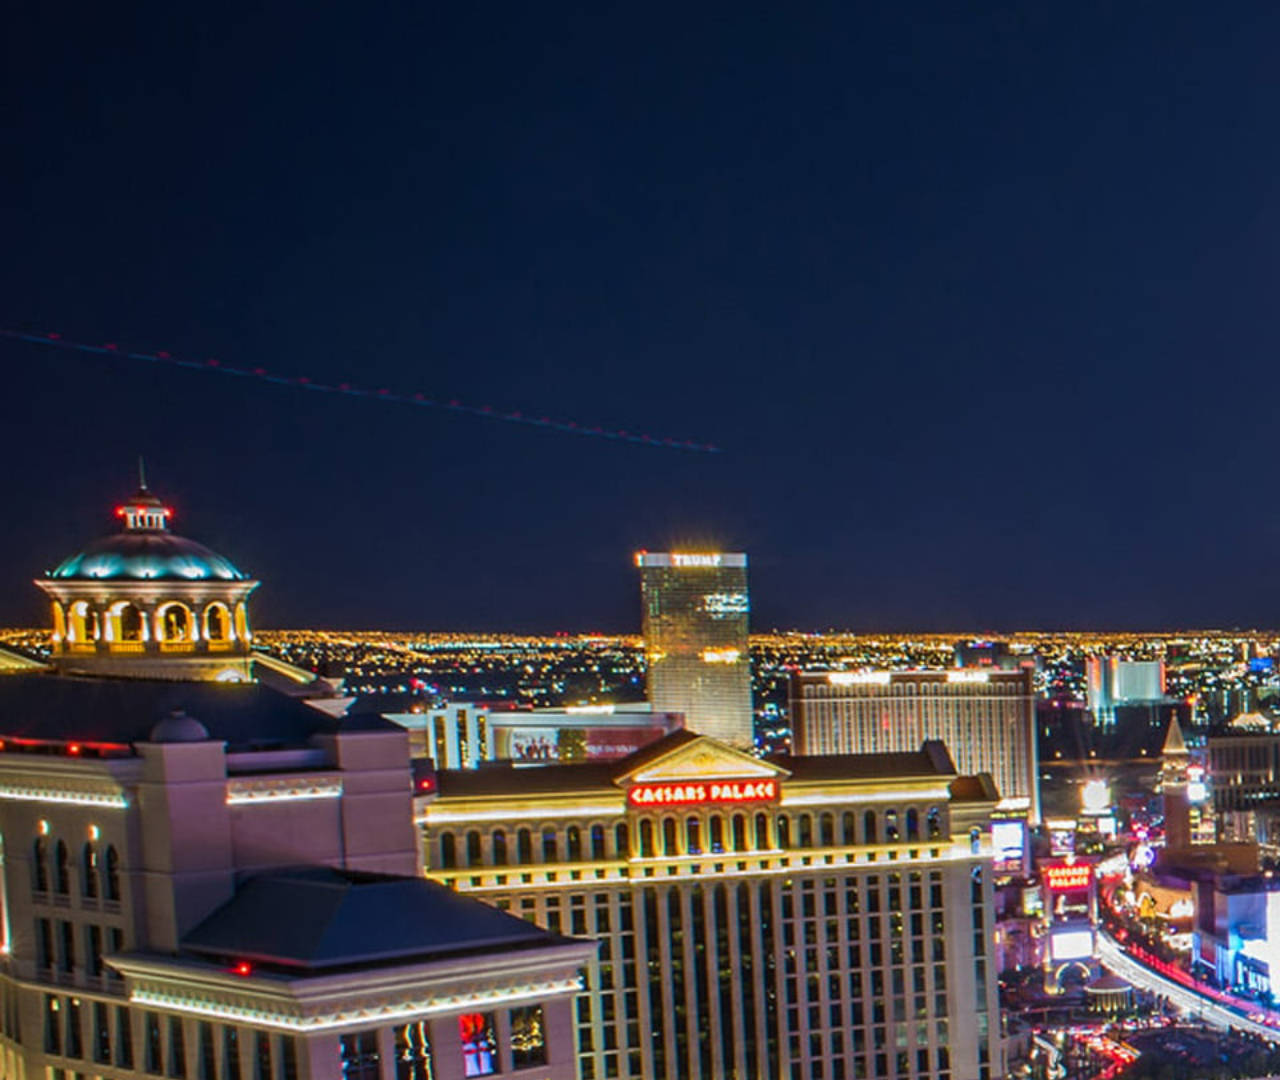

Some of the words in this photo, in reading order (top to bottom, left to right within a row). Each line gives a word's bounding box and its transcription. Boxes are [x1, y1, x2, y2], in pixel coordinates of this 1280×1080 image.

[672, 553, 720, 567] TRUMP
[631, 785, 706, 803] CAESARS
[711, 782, 774, 799] PALACE
[1049, 876, 1089, 887] PALACE
